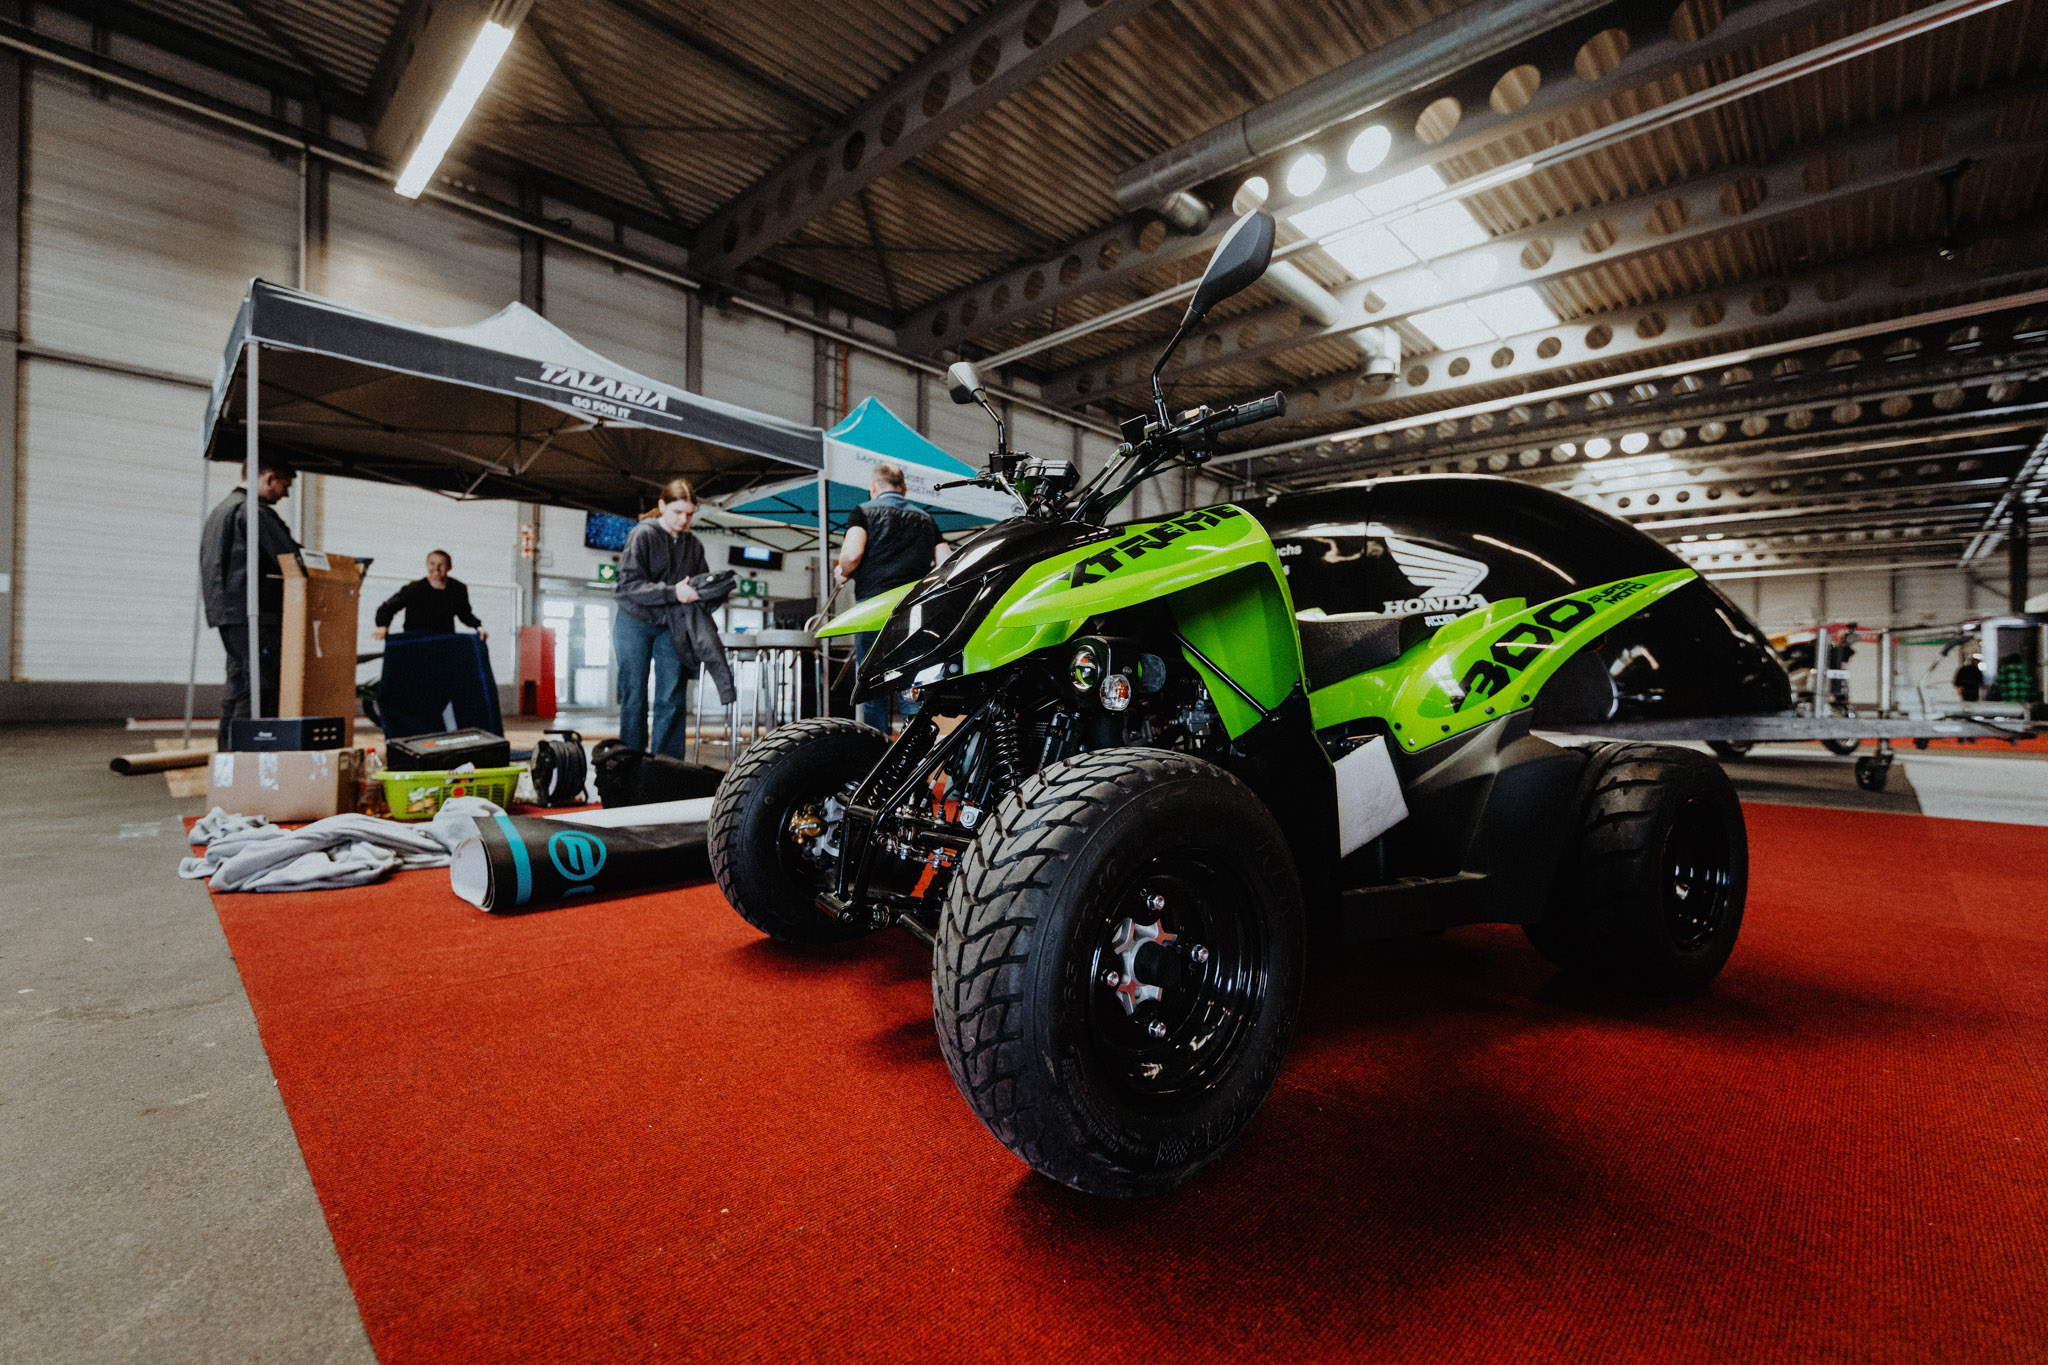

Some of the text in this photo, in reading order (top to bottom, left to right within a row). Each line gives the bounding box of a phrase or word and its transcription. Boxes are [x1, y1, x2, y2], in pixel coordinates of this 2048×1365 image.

[540, 362, 669, 411] TALARIA
[572, 396, 631, 419] GO FOR IT
[1058, 505, 1242, 589] XTREME
[1383, 593, 1489, 615] HONDA
[1587, 581, 1632, 604] SUPER
[1604, 584, 1648, 605] MOTO
[1451, 599, 1596, 713] 300
